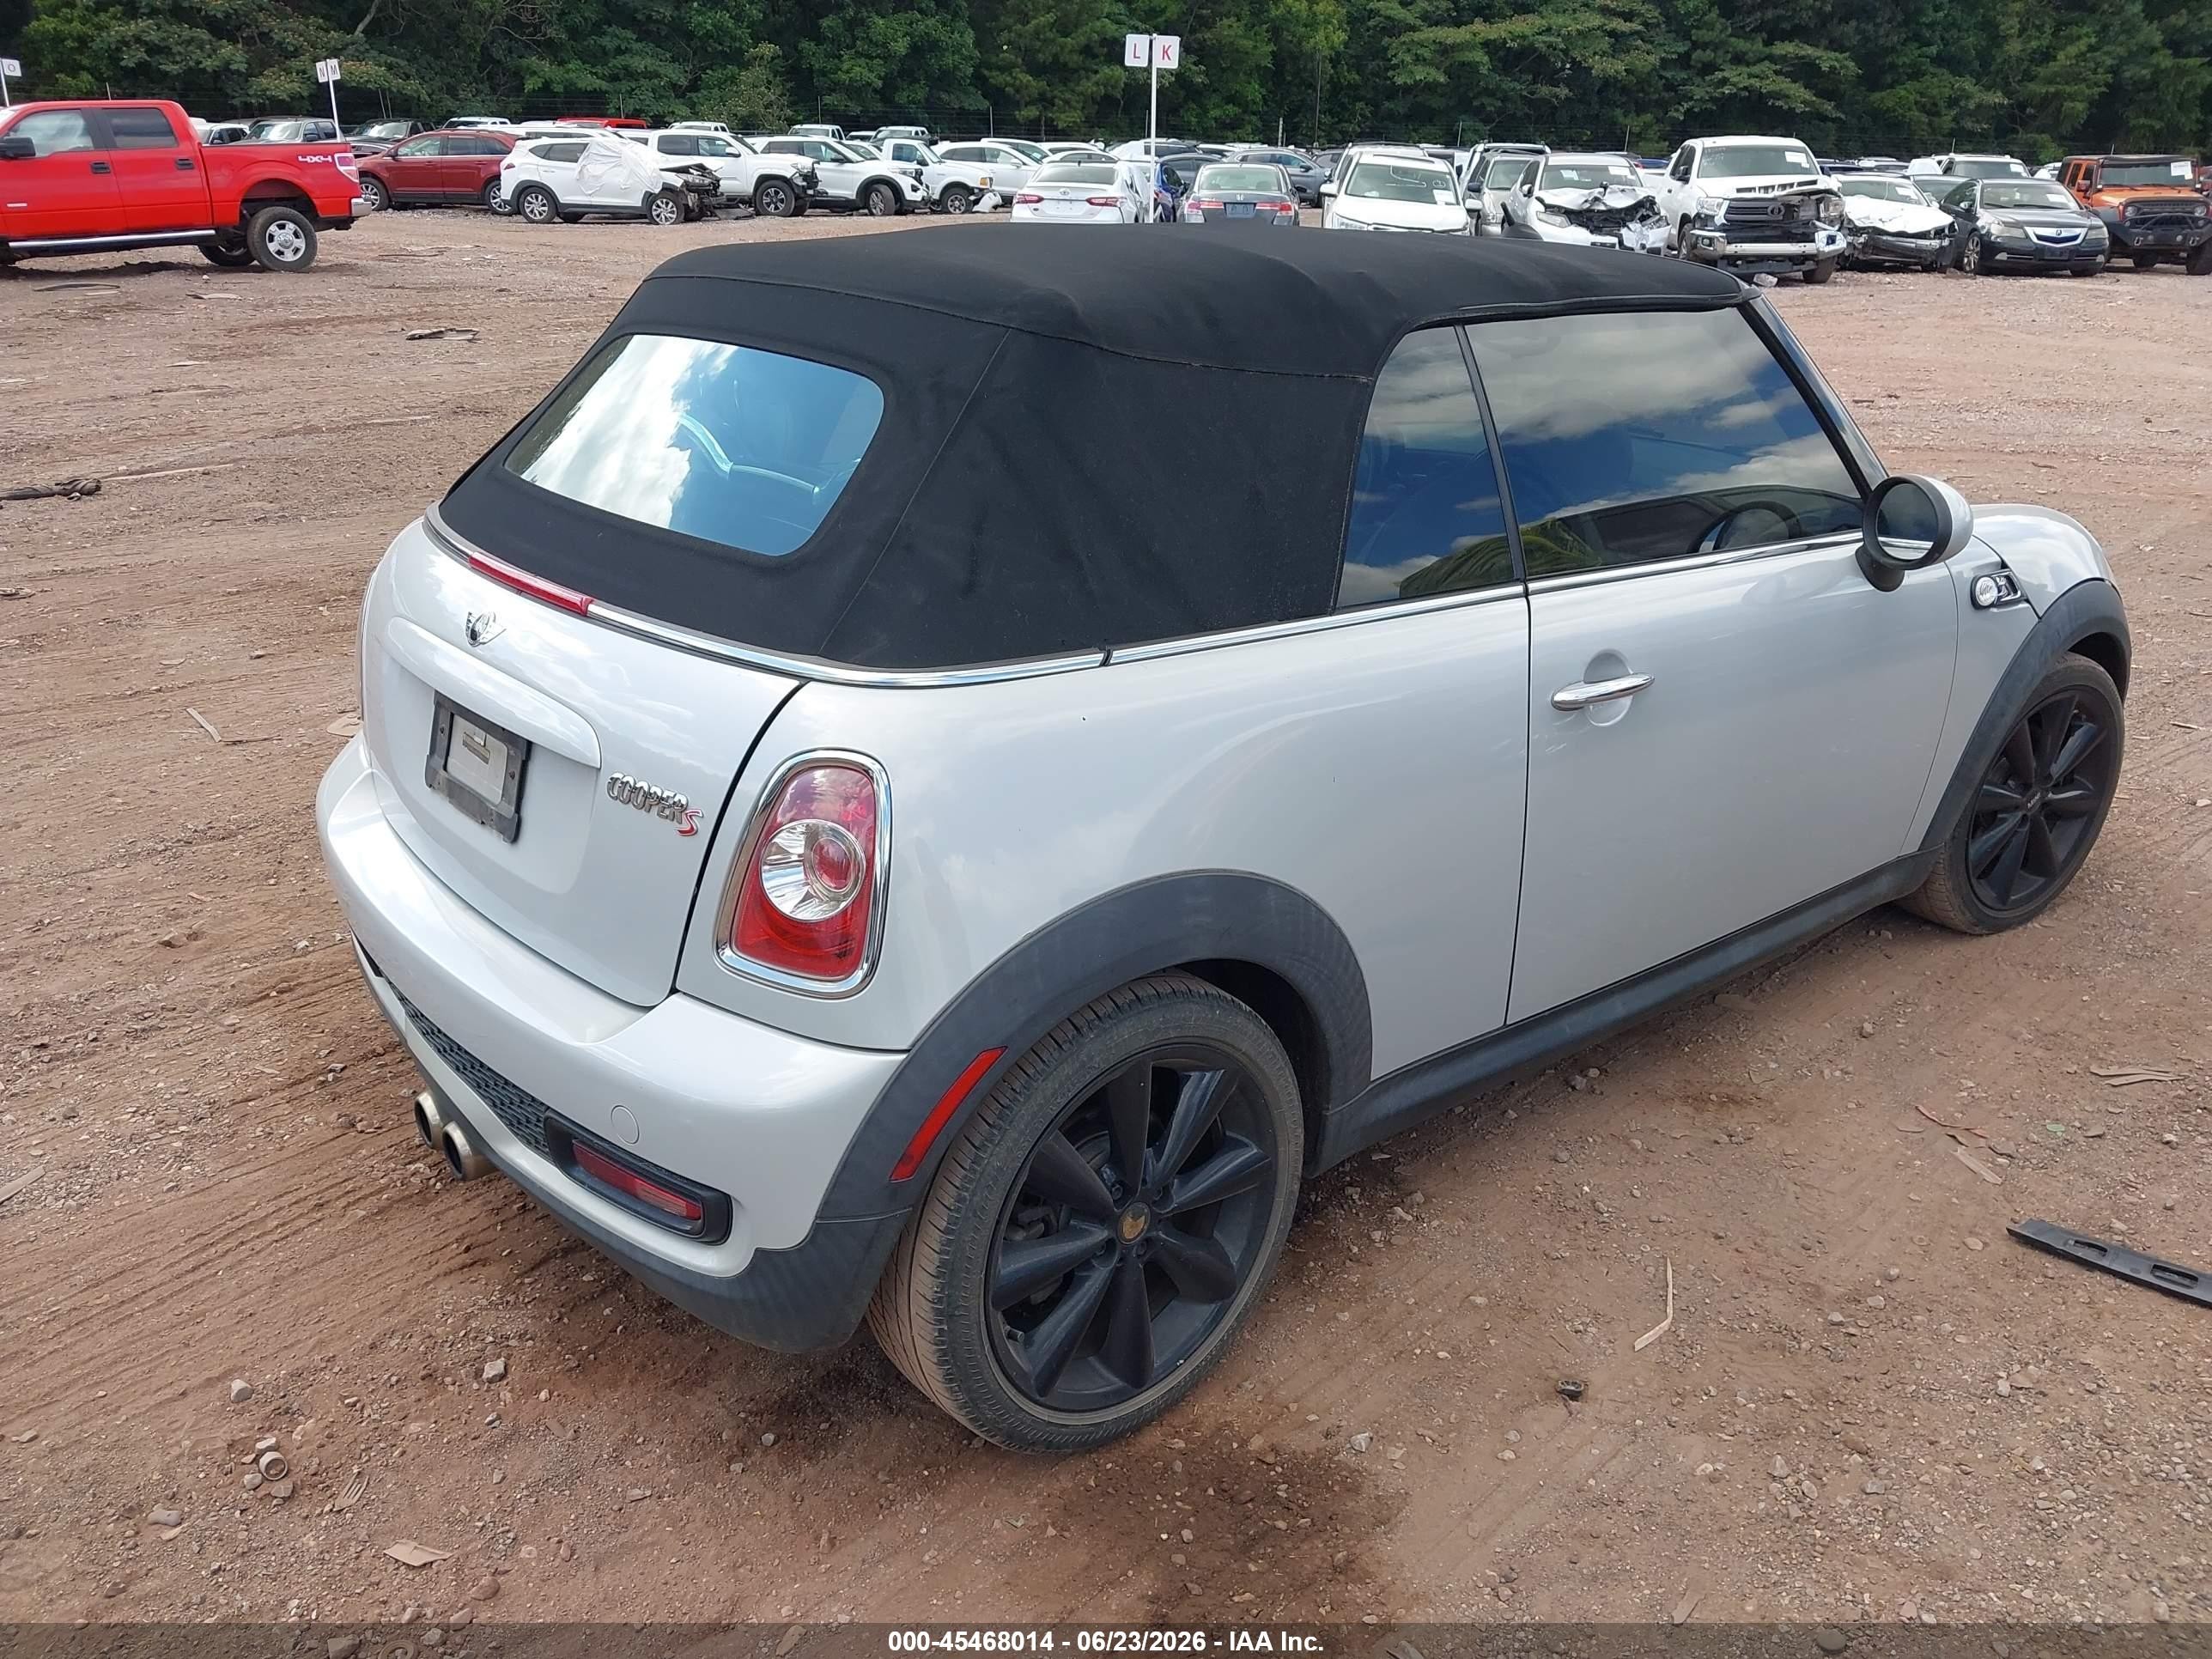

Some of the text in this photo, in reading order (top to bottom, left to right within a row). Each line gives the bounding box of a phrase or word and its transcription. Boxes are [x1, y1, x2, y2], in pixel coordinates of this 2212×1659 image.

[1133, 43, 1141, 59] L
[1162, 45, 1172, 61] K
[319, 66, 325, 77] N
[331, 64, 338, 75] M
[606, 772, 704, 836] COOPER S
